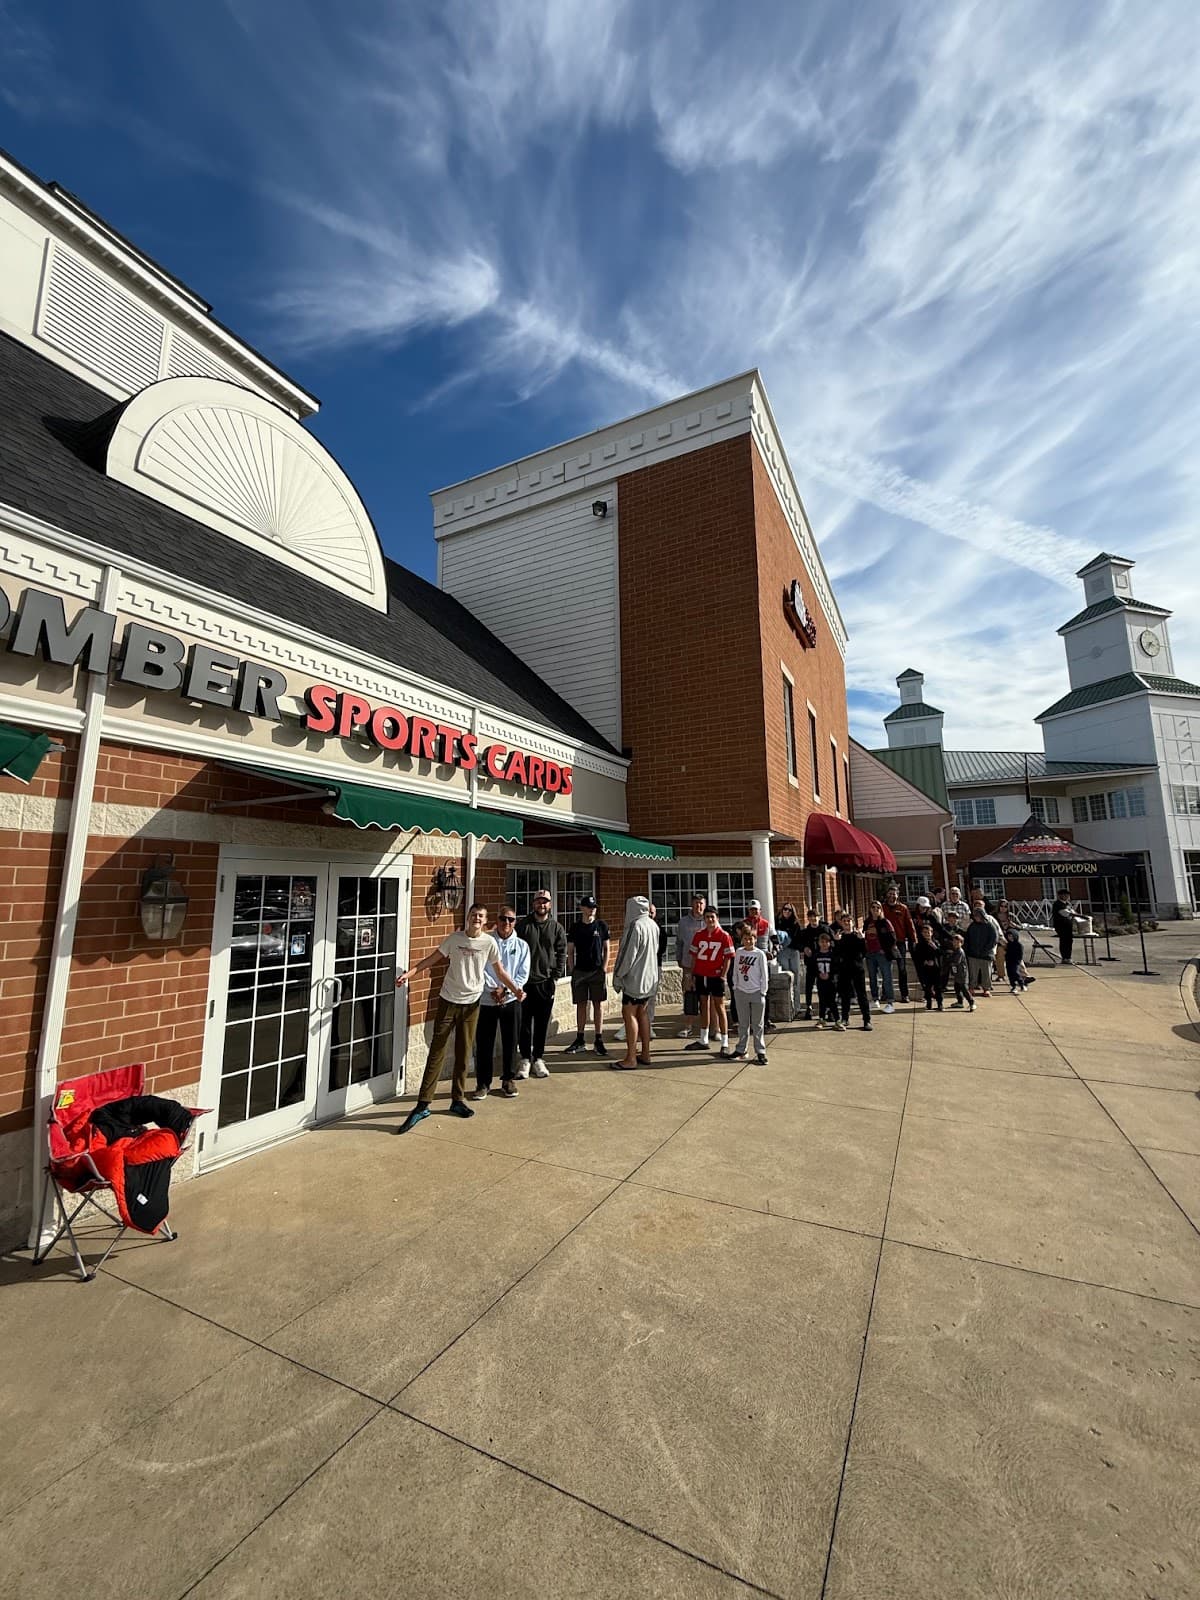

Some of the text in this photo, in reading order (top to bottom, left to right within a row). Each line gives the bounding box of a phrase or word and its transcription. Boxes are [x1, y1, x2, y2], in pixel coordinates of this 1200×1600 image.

[0, 586, 574, 795] MBER SPORTS CARDS
[1001, 863, 1098, 875] GOURMET POPCORN
[698, 940, 722, 961] 27
